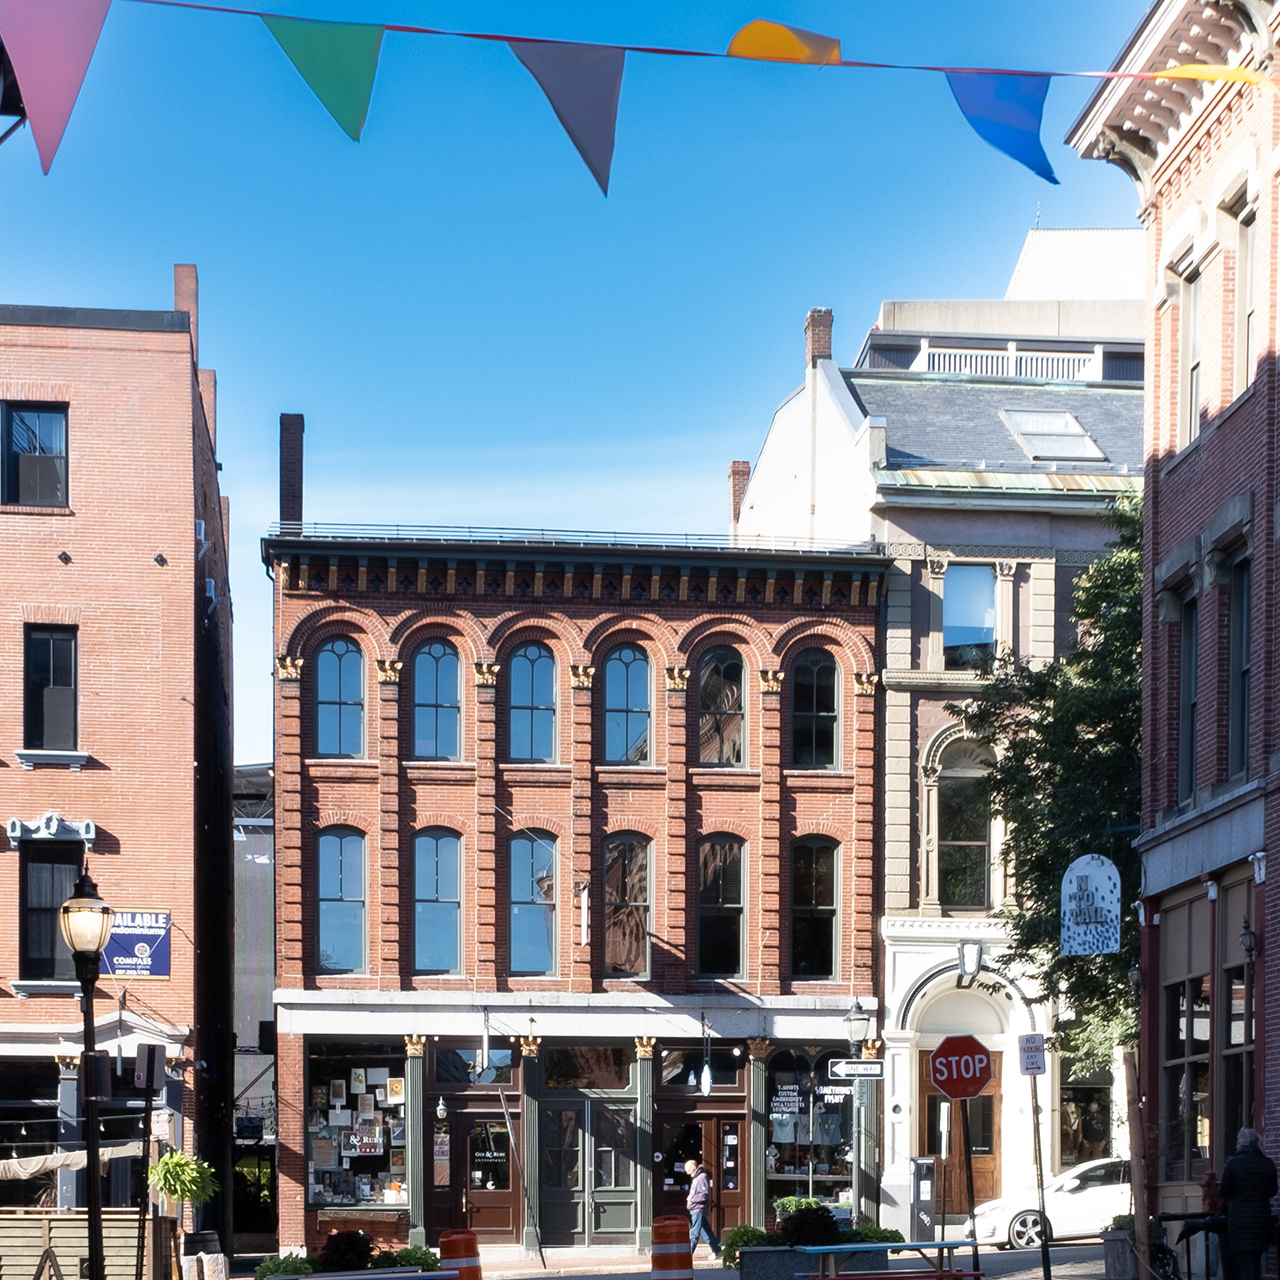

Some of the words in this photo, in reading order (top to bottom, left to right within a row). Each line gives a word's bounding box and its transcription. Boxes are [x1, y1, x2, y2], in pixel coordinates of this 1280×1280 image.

[112, 913, 167, 927] AILABLE
[113, 957, 152, 965] COMPASS
[1025, 1036, 1036, 1044] NO
[1021, 1045, 1043, 1053] PARKING
[935, 1054, 987, 1081] STOP
